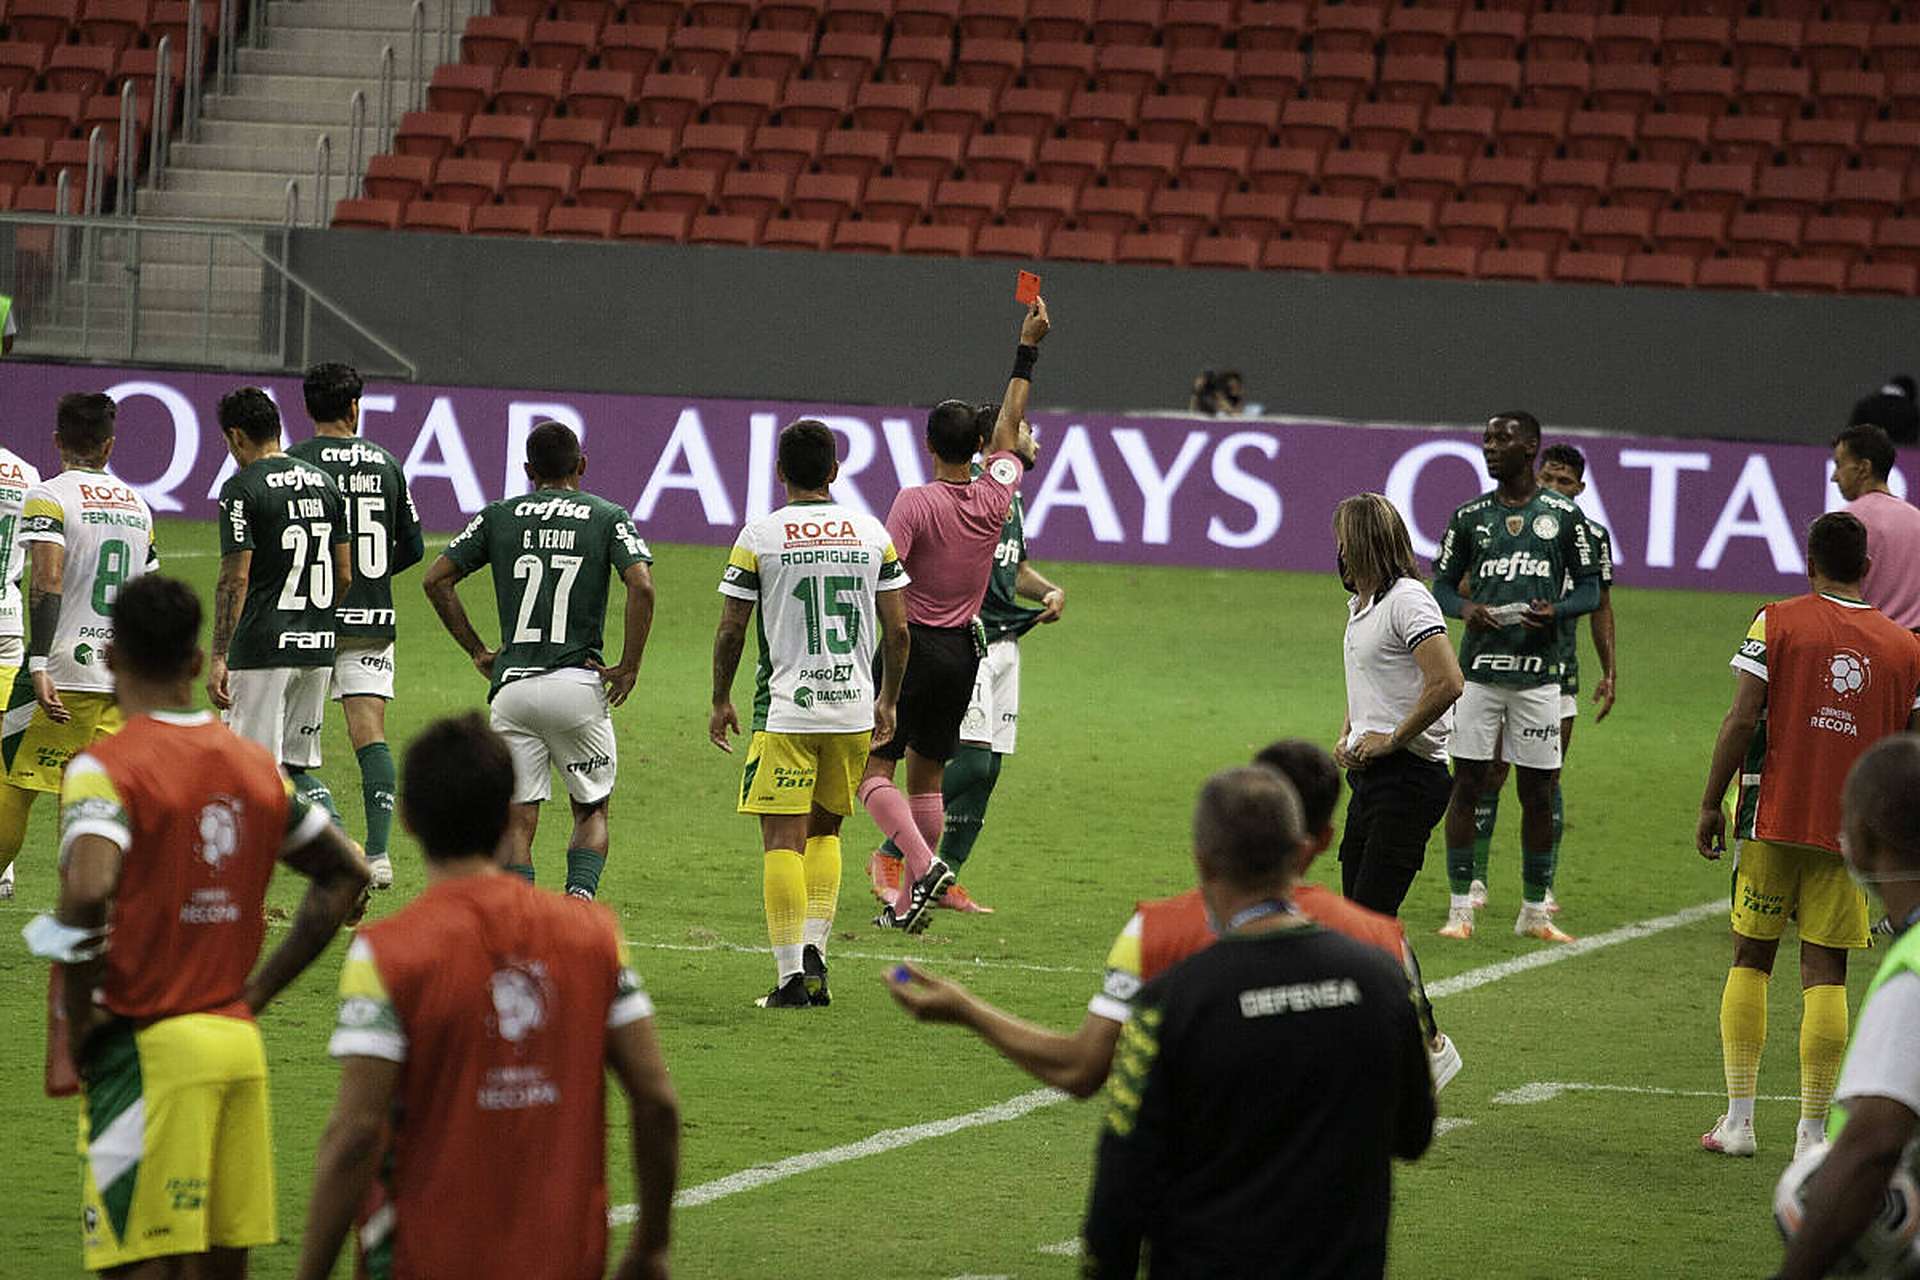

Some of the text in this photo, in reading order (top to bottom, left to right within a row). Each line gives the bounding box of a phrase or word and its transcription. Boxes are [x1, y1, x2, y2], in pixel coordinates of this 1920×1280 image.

[320, 444, 386, 467] crefisa
[265, 465, 325, 490] crefisa
[632, 407, 1284, 548] AIRAYS
[1385, 438, 1908, 574] QTA
[79, 484, 138, 504] ROCA
[514, 497, 592, 521] crefisa
[228, 499, 248, 544] crefisa
[783, 520, 857, 541] ROCA
[523, 529, 576, 550] G. VERON
[91, 539, 131, 617] 8
[276, 523, 335, 611] 23
[1479, 551, 1550, 582] crefisa
[511, 554, 584, 644] 27
[792, 575, 864, 656] 15
[1810, 716, 1858, 737] RECOPA
[1239, 978, 1362, 1019] DEFENSA
